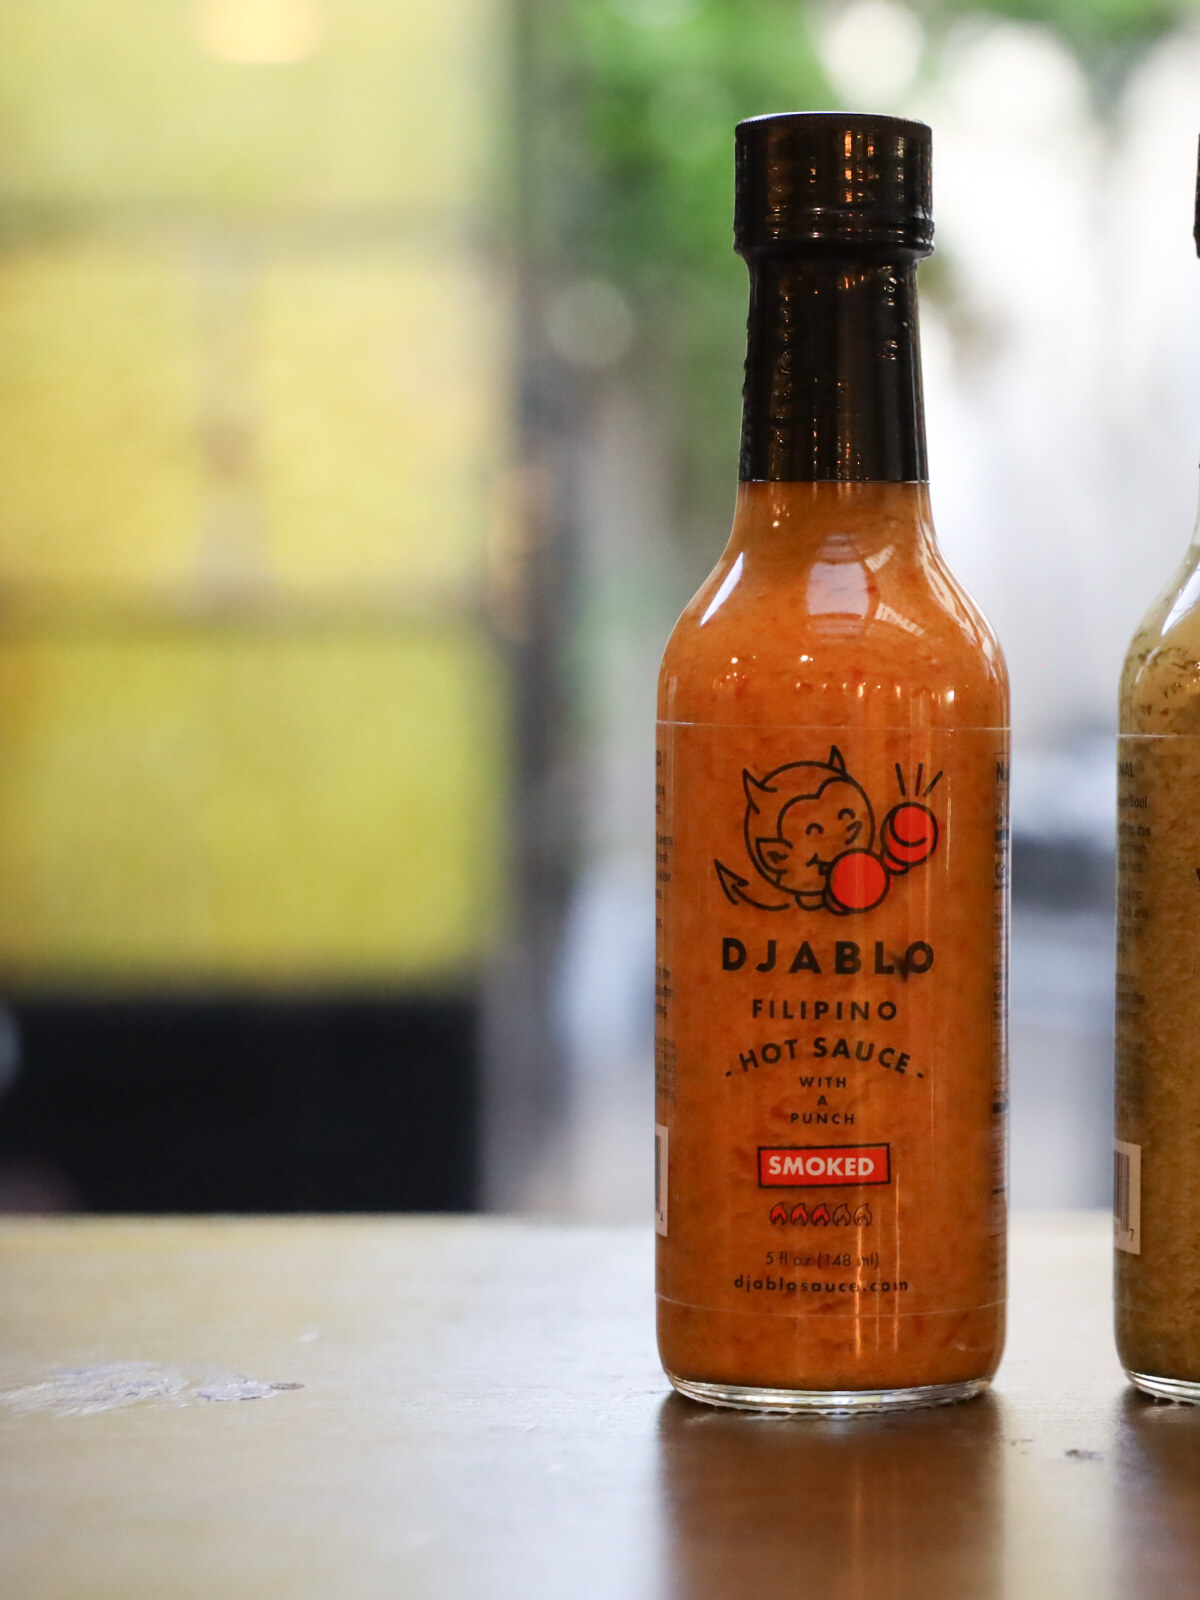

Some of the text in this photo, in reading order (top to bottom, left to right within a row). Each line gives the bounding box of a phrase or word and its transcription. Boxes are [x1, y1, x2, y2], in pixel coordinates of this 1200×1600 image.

[722, 937, 934, 975] DJABLO
[752, 999, 897, 1020] FILIPINO
[738, 1037, 911, 1075] HOT SAUCE
[799, 1076, 847, 1088] WITH
[817, 1095, 828, 1106] A
[790, 1113, 855, 1125] PUNCH
[768, 1155, 875, 1177] SMOKED
[765, 1252, 773, 1265] 5
[779, 1252, 788, 1265] fl
[793, 1257, 811, 1267] oz
[817, 1252, 851, 1269] (148
[734, 1274, 909, 1293] djablosauce.com
